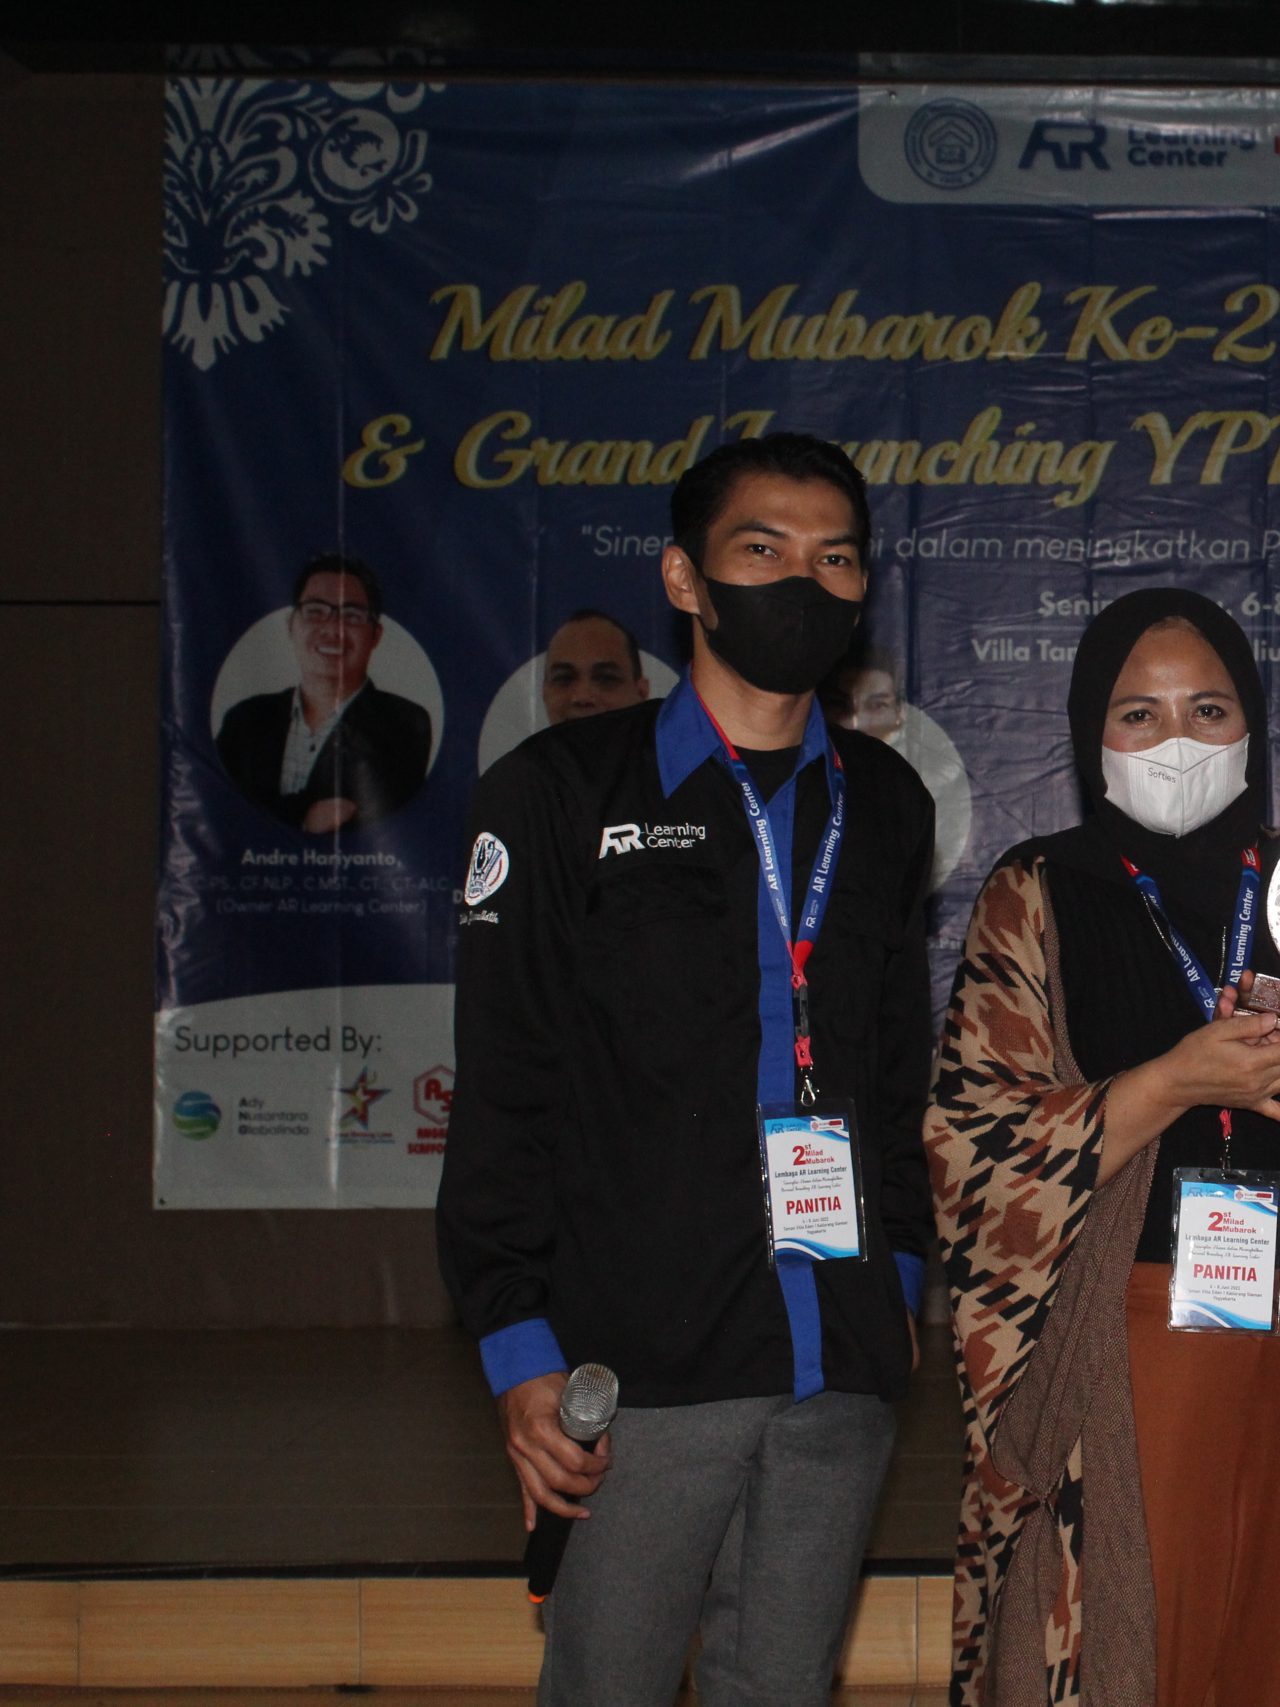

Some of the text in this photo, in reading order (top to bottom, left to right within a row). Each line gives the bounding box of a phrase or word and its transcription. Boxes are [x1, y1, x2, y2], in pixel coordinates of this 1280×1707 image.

[1127, 145, 1227, 167] Center
[429, 280, 675, 363] Milad
[688, 280, 1048, 363] Mubarok
[1063, 283, 1280, 363] Ke-2
[342, 414, 426, 489] &
[453, 408, 714, 488] Grand
[895, 528, 1003, 559] dalam
[1012, 528, 1250, 566] meningkatkan
[972, 638, 1031, 662] Villa
[645, 822, 706, 840] Learning
[741, 782, 779, 890] AR Learning Center
[646, 836, 696, 849] Center
[816, 828, 840, 873] Learning
[241, 848, 299, 866] Andre
[812, 877, 825, 893] AR
[1229, 888, 1255, 984] AR Learning Center
[174, 1025, 382, 1059] Supported By:
[792, 1145, 807, 1166] 2
[786, 1196, 842, 1215] PANITIA
[1207, 1211, 1223, 1232] 2
[1223, 1218, 1245, 1226] Milad
[1223, 1225, 1257, 1234] Mubarok
[1223, 1236, 1249, 1245] Learning
[1250, 1238, 1270, 1246] Center
[1193, 1263, 1258, 1282] PANITIA
